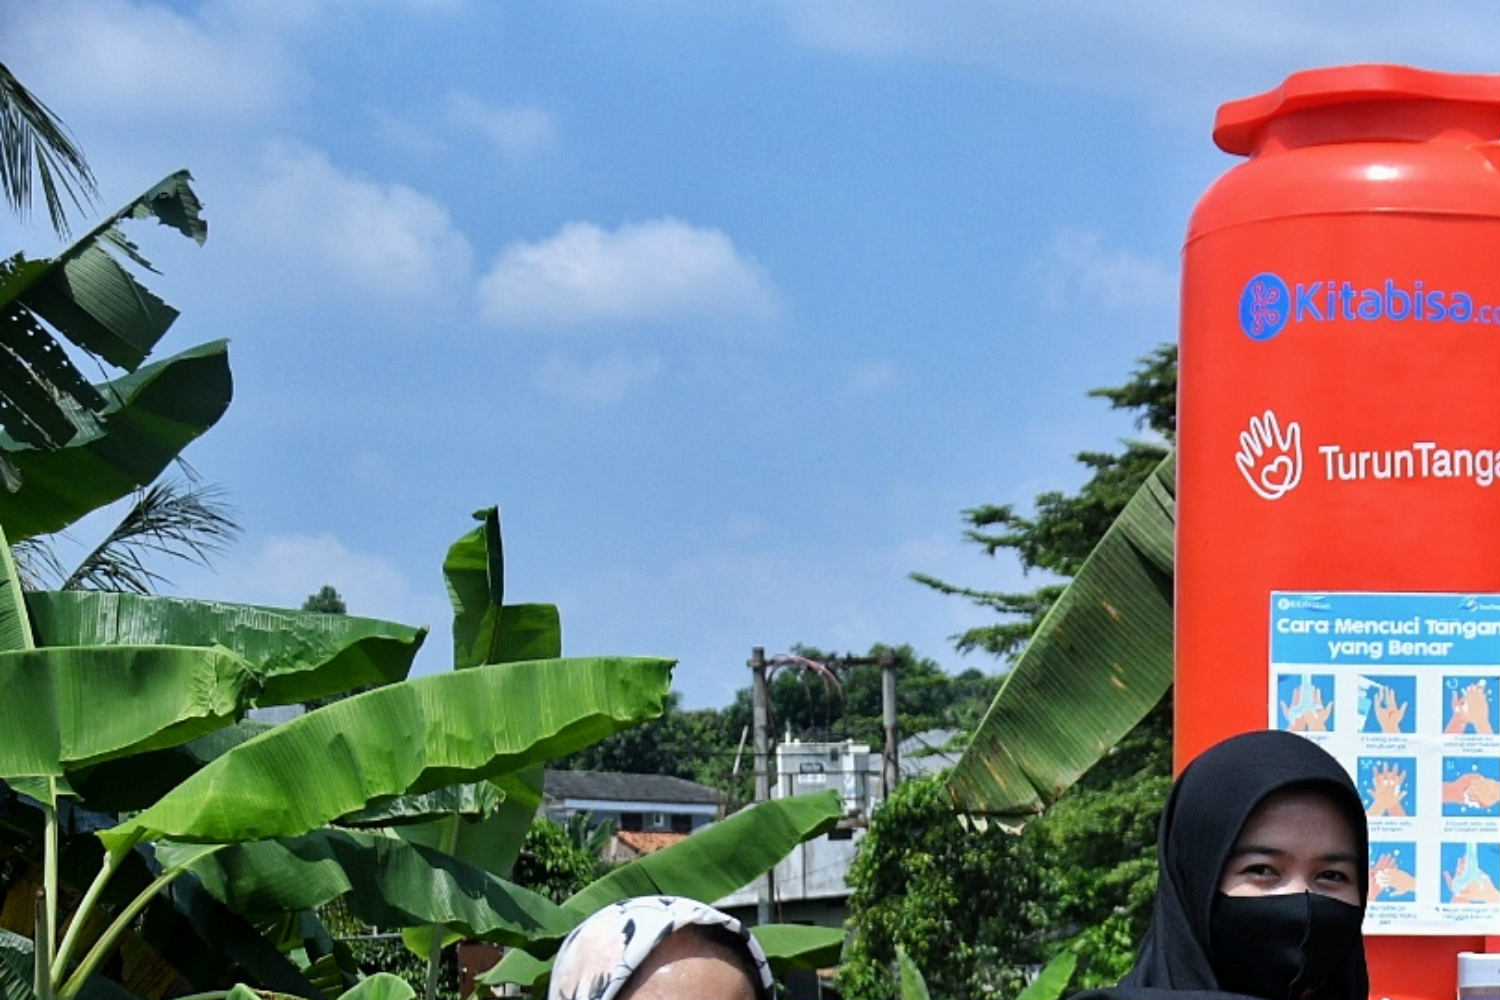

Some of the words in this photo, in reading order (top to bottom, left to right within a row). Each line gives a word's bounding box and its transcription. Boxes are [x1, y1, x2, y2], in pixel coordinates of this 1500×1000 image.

[1276, 617, 1329, 635] Cara
[1334, 616, 1420, 636] Mencuci
[1327, 640, 1383, 659] yang
[1388, 640, 1453, 656] Benar
